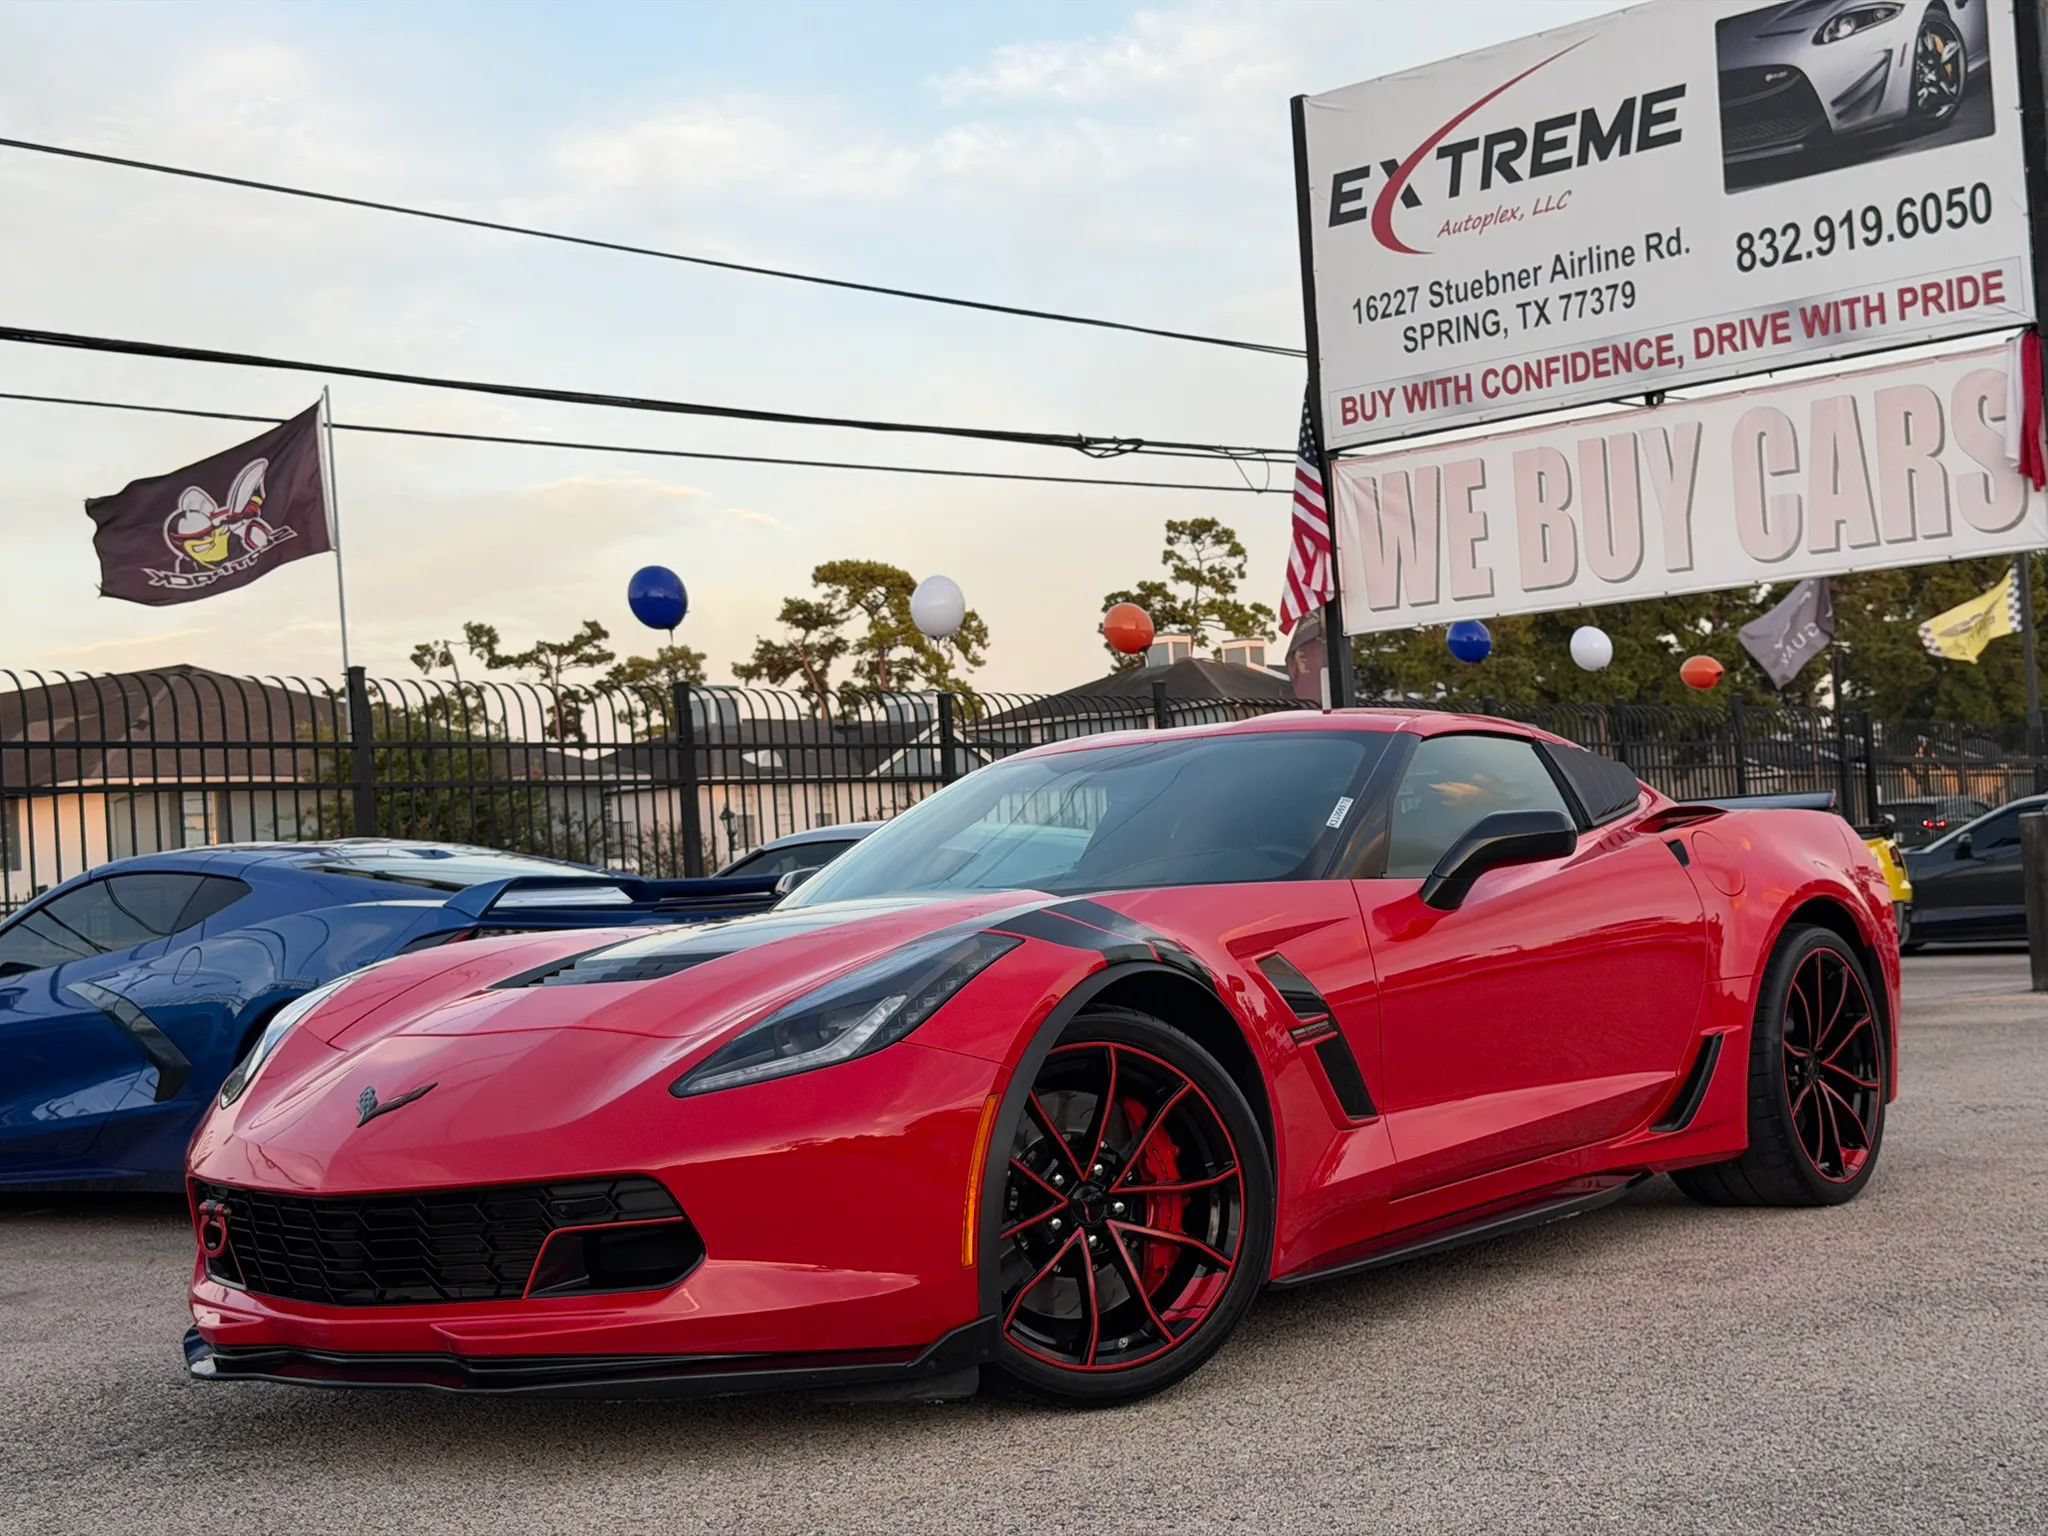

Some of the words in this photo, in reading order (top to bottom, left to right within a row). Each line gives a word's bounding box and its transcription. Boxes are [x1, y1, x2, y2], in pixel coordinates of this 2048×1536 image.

[1328, 83, 1687, 228] EXTREME
[1437, 204, 1525, 238] Autoplex,
[1532, 190, 1572, 217] LLC
[1736, 182, 1993, 273] 832.919.6050
[1352, 286, 1420, 325] 16227
[1428, 263, 1543, 309] Stuebner
[1549, 244, 1636, 283] Airline
[1644, 227, 1691, 263] Rd.
[1402, 309, 1509, 354] SPRING,
[1516, 297, 1552, 331] TX
[1558, 280, 1636, 322] 77379
[1340, 387, 1396, 426] BUY
[1402, 372, 1474, 413] WITH
[1481, 333, 1686, 400] CONFIDENCE,
[1692, 310, 1792, 360] DRIVE
[1799, 292, 1887, 340] WITH
[1896, 269, 2006, 321] PRIDE
[1352, 457, 1495, 612] WE
[1512, 421, 1703, 592] BUY
[1731, 368, 2029, 564] CARS
